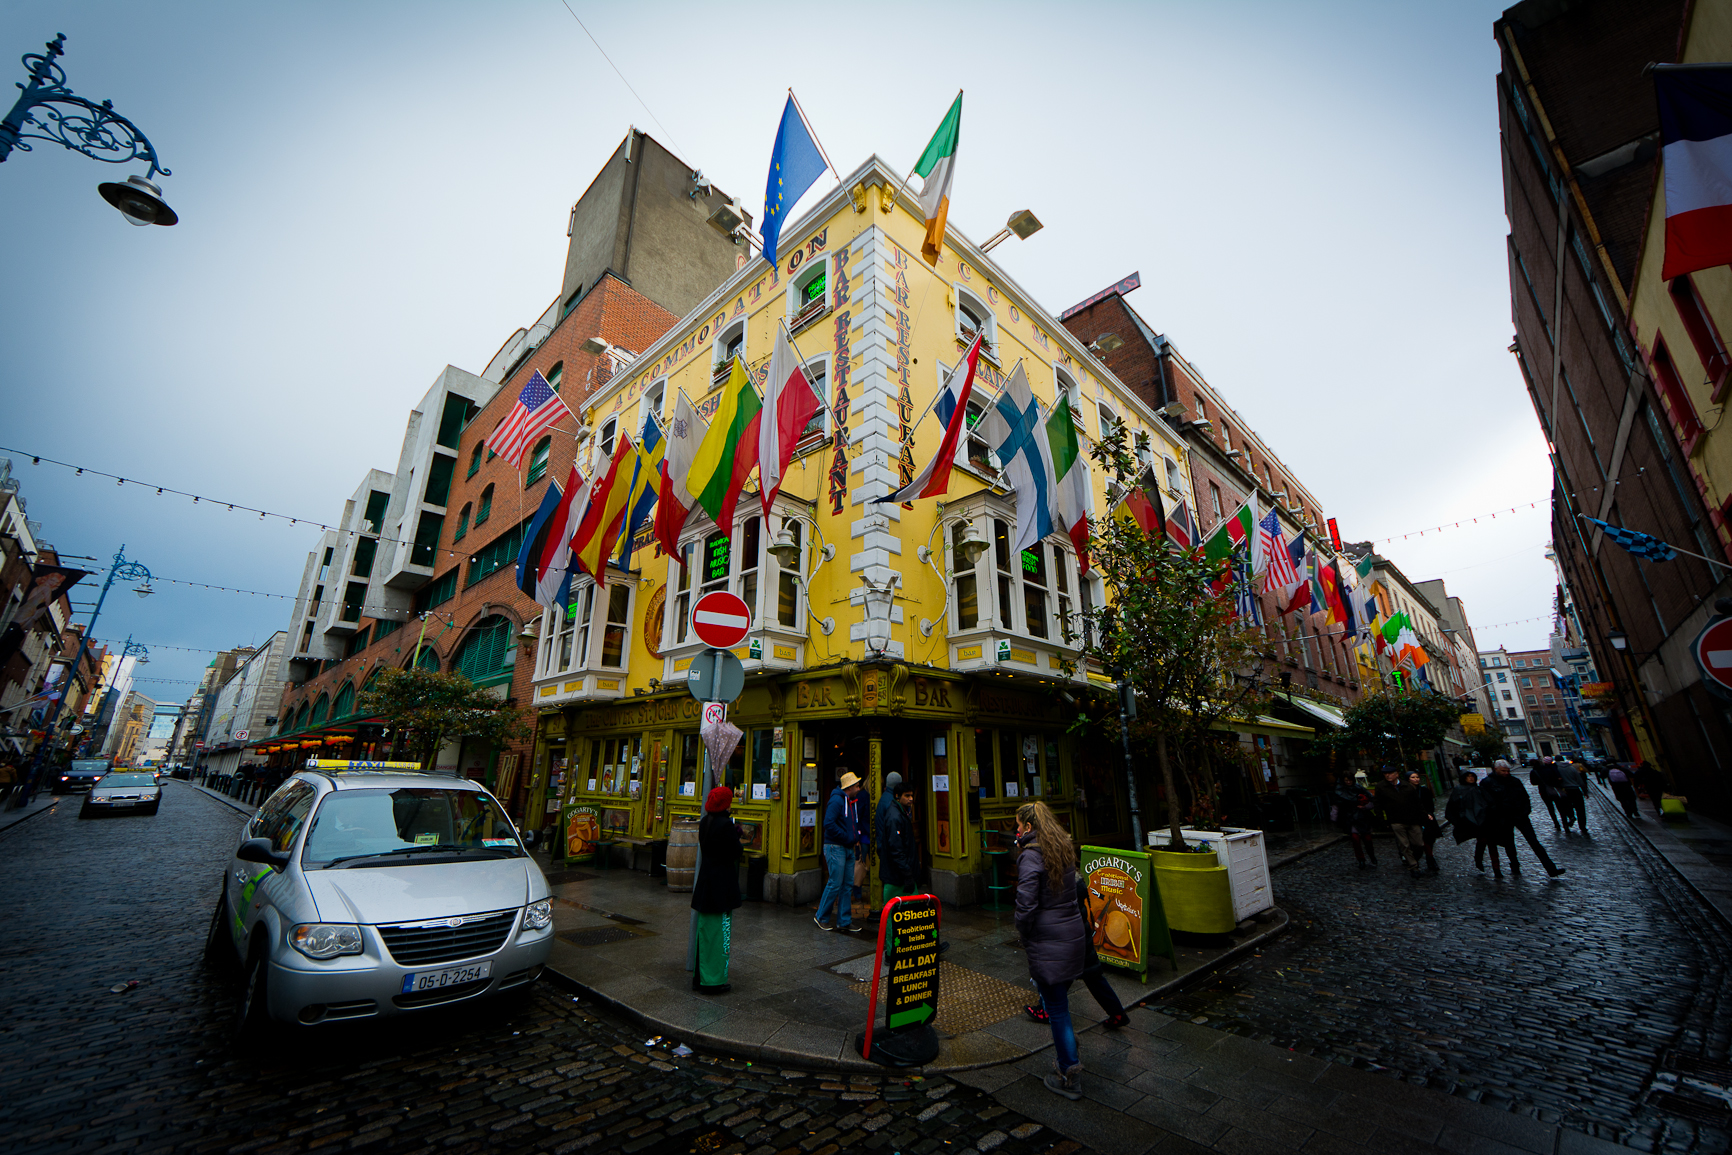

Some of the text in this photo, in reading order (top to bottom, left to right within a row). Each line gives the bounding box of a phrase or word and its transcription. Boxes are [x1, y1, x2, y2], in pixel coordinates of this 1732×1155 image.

[829, 249, 851, 517] BAR RESTAURANT
[893, 247, 917, 510] BAR RESTAURAN
[796, 679, 835, 709] BAR
[913, 677, 952, 709] BAR
[1084, 856, 1143, 883] GOGARTY'S
[893, 908, 936, 923] O'Shea's
[896, 922, 935, 936] Traditional
[896, 940, 936, 954] Restaurant
[908, 934, 926, 943] Irish
[894, 953, 937, 971] ALL DAY
[418, 966, 482, 990] 05-D-2254
[892, 968, 937, 984] BREAKFAST
[901, 981, 928, 994] LUNCH
[896, 990, 932, 1006] & DINNER
